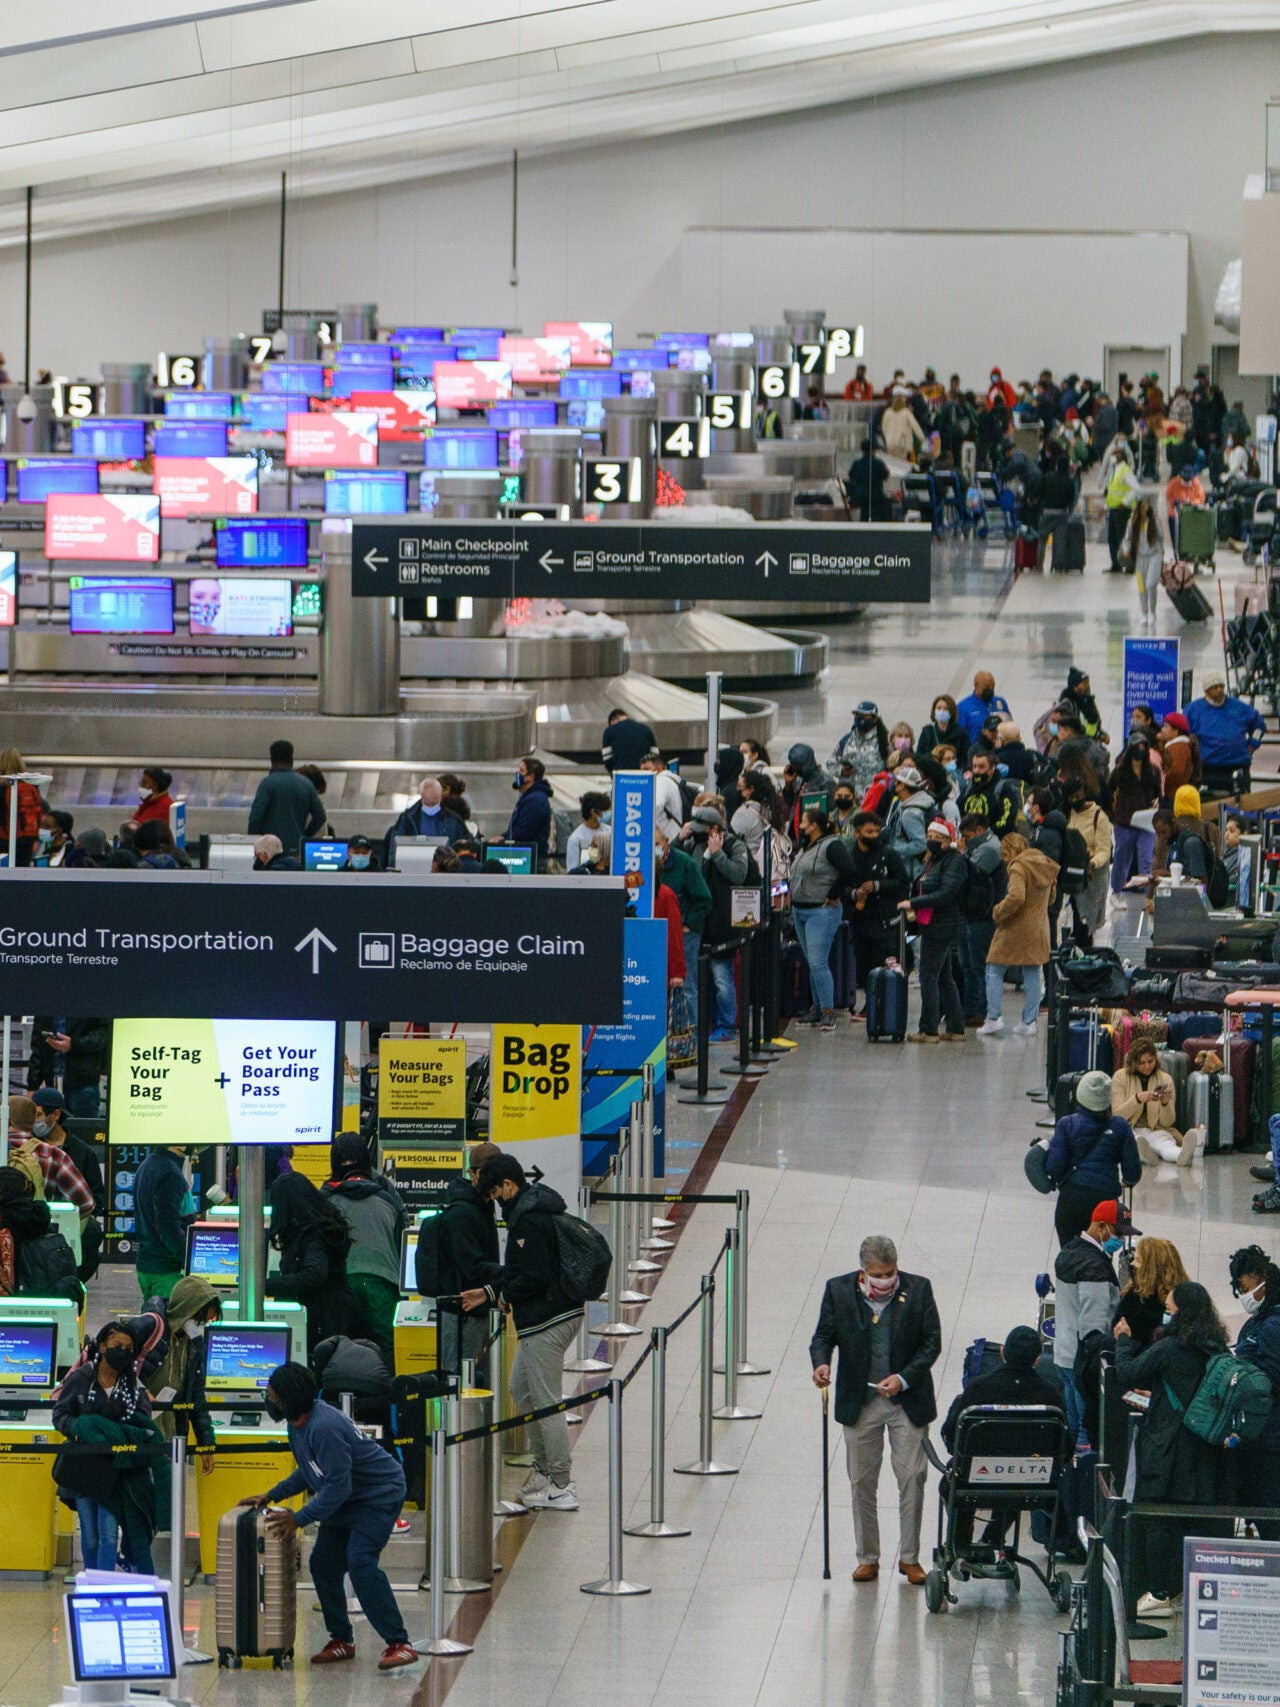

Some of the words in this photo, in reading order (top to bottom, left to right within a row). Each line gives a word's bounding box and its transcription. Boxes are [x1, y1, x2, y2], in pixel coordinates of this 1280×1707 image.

[831, 329, 850, 356] 8
[251, 338, 272, 363] 7
[800, 346, 820, 373] 7
[172, 358, 195, 386] 6
[762, 367, 786, 398] 6
[69, 386, 92, 418] 5
[711, 396, 734, 428] 5
[666, 423, 693, 456] 4
[594, 464, 621, 501] 3
[421, 539, 452, 551] Main
[455, 539, 529, 553] Checkpoint
[422, 552, 444, 560] Control
[596, 551, 645, 564] Ground
[649, 552, 744, 567] Transportation
[812, 554, 870, 568] Baggage
[874, 554, 910, 568] Claim
[421, 563, 490, 576] Restrooms
[597, 564, 632, 574] Transporte
[156, 646, 167, 655] Do
[168, 646, 182, 656] Not
[232, 648, 247, 658] Play
[248, 648, 260, 657] On
[261, 648, 294, 658] Carousel
[1127, 671, 1154, 680] Please
[1156, 672, 1174, 682] wait
[1127, 690, 1168, 699] oversized
[625, 792, 642, 837] BAG
[625, 842, 640, 902] DRP
[95, 928, 274, 952] Transportation
[400, 934, 510, 957] Baggage
[517, 935, 585, 956] Claim
[0, 952, 64, 966] Transporte
[66, 954, 118, 965] Terrestre
[400, 958, 454, 970] Reclamo
[456, 960, 472, 970] de
[475, 960, 528, 972] Equipaje
[627, 958, 638, 969] in
[641, 1014, 656, 1022] pass
[615, 1034, 636, 1042] flights
[131, 1047, 202, 1064] Self-Tag
[242, 1046, 272, 1060] Get
[278, 1046, 318, 1060] Your
[438, 1046, 459, 1054] spirit
[503, 1036, 570, 1075] Bag
[130, 1066, 170, 1079] Your
[389, 1060, 443, 1071] Measure
[242, 1065, 320, 1081] Boarding
[389, 1072, 420, 1084] Your
[422, 1072, 454, 1086] Bags
[214, 1072, 231, 1089] +
[502, 1071, 570, 1100] Drop
[130, 1084, 162, 1101] Bag
[242, 1084, 280, 1096] Pass
[295, 1126, 322, 1134] spirit
[121, 1175, 128, 1188] 3
[173, 1402, 194, 1410] spirit
[394, 1436, 414, 1445] spirit
[112, 1444, 138, 1453] spirit
[195, 1444, 216, 1452] spirit
[994, 1466, 1048, 1474] DELTA
[1195, 1554, 1228, 1564] Checked
[1230, 1556, 1264, 1567] Baggage
[1201, 1690, 1220, 1698] Your
[1221, 1690, 1246, 1701] safety
[1248, 1692, 1256, 1700] is
[1257, 1694, 1272, 1702] our
